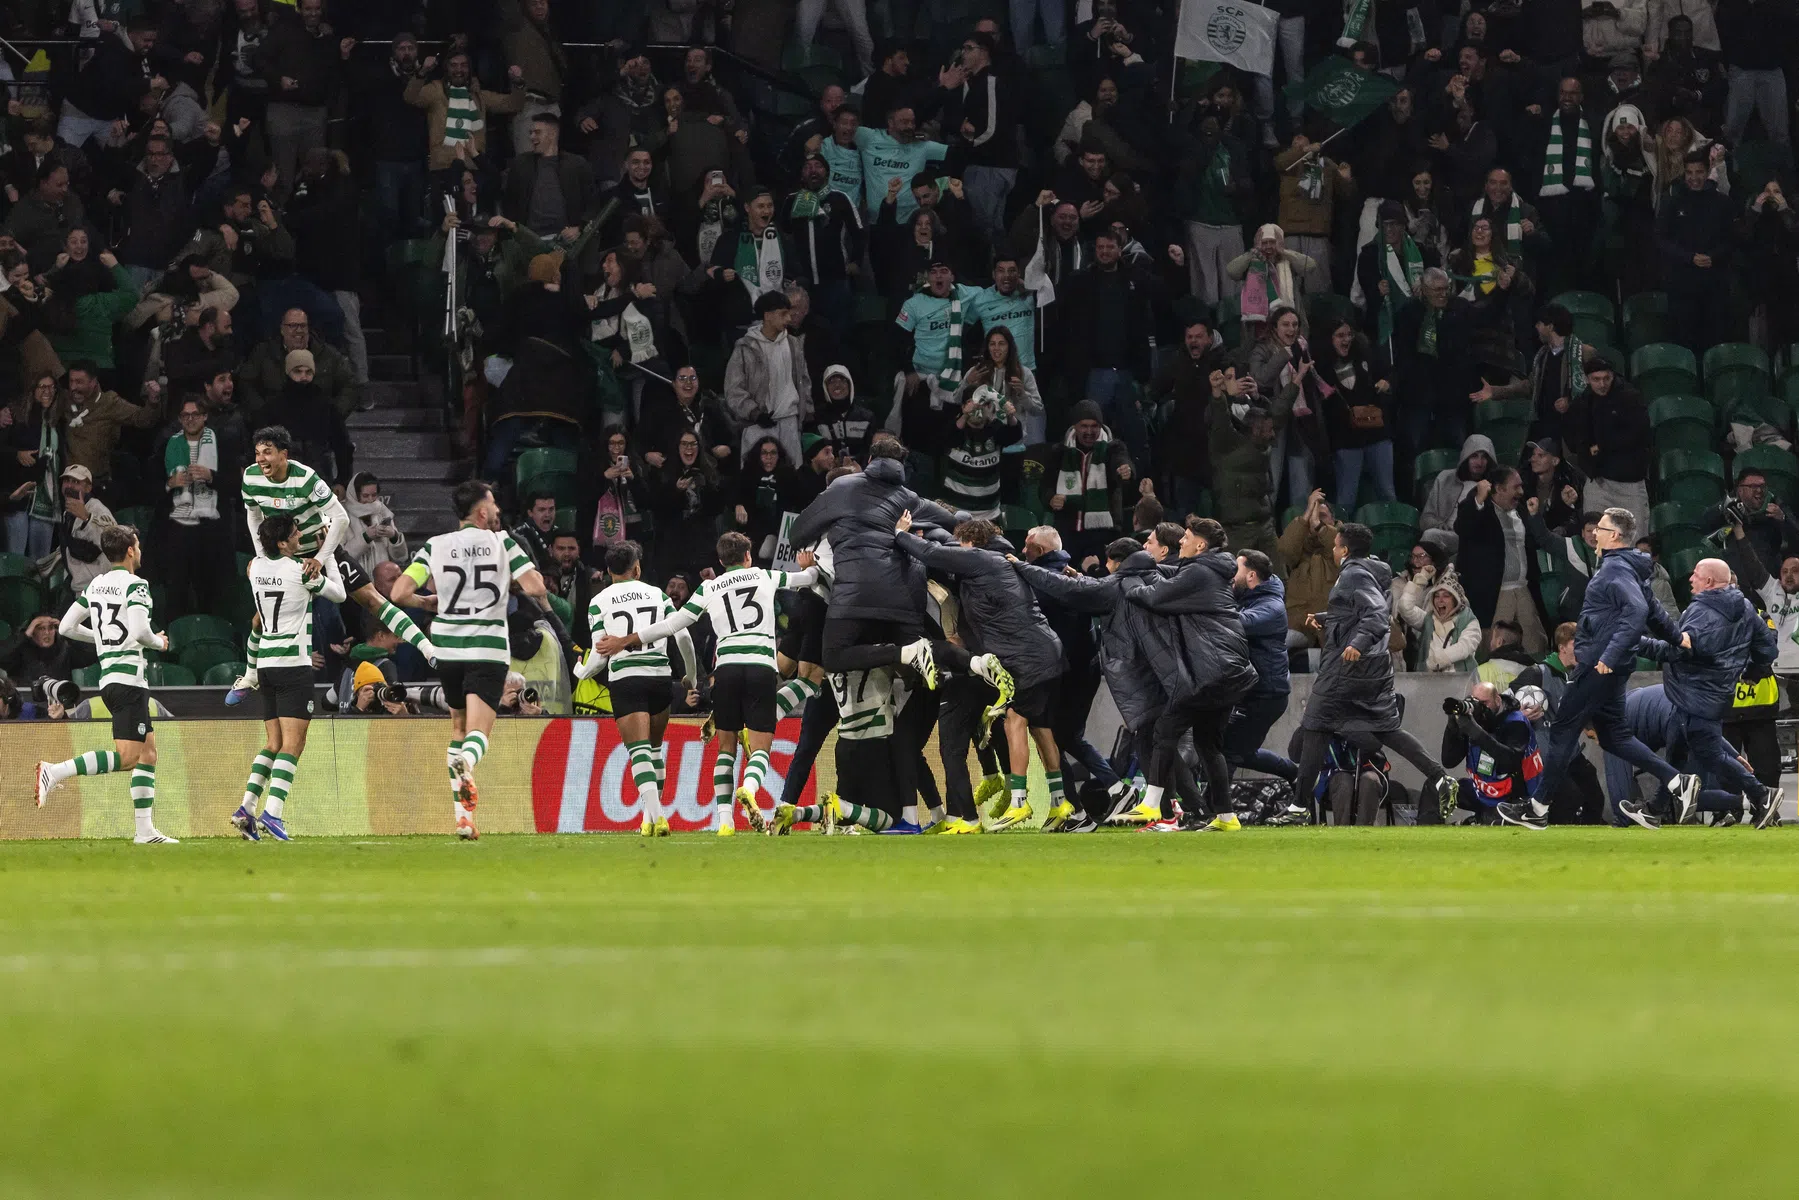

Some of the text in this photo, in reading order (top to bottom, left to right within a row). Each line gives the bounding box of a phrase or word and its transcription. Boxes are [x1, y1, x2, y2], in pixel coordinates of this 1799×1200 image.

[1216, 6, 1244, 17] SCP
[873, 157, 910, 170] Betano
[930, 321, 951, 331] Bet
[961, 455, 998, 466] Betano
[451, 548, 460, 559] G.
[443, 565, 501, 615] 25
[711, 572, 761, 593] VAGIANNIDIS
[611, 592, 643, 605] ALISSON
[255, 591, 285, 634] 17
[721, 585, 764, 633] 13
[91, 601, 129, 646] 23
[612, 606, 658, 652] 27
[1736, 685, 1757, 701] 64
